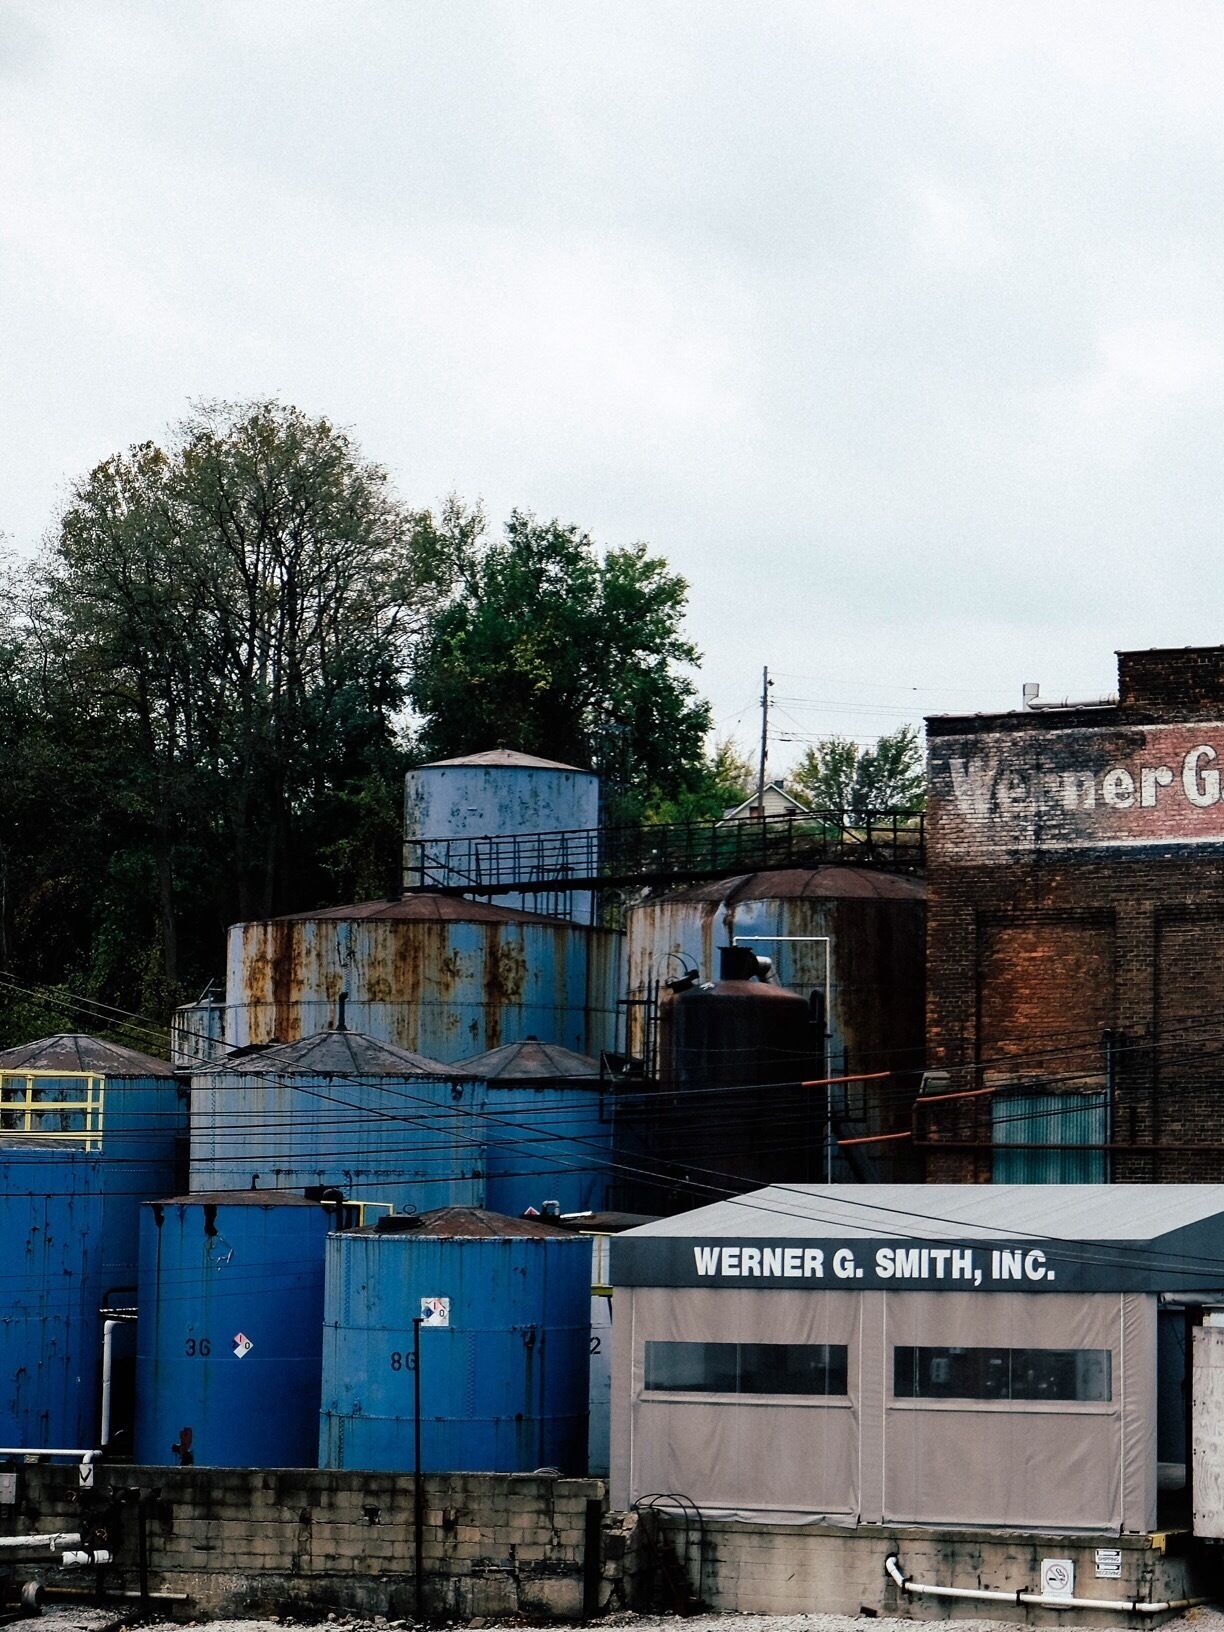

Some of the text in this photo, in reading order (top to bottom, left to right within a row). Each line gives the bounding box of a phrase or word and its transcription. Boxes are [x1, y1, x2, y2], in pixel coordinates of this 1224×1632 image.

[693, 1246, 1056, 1287] WERNER G. SMITH, INC.
